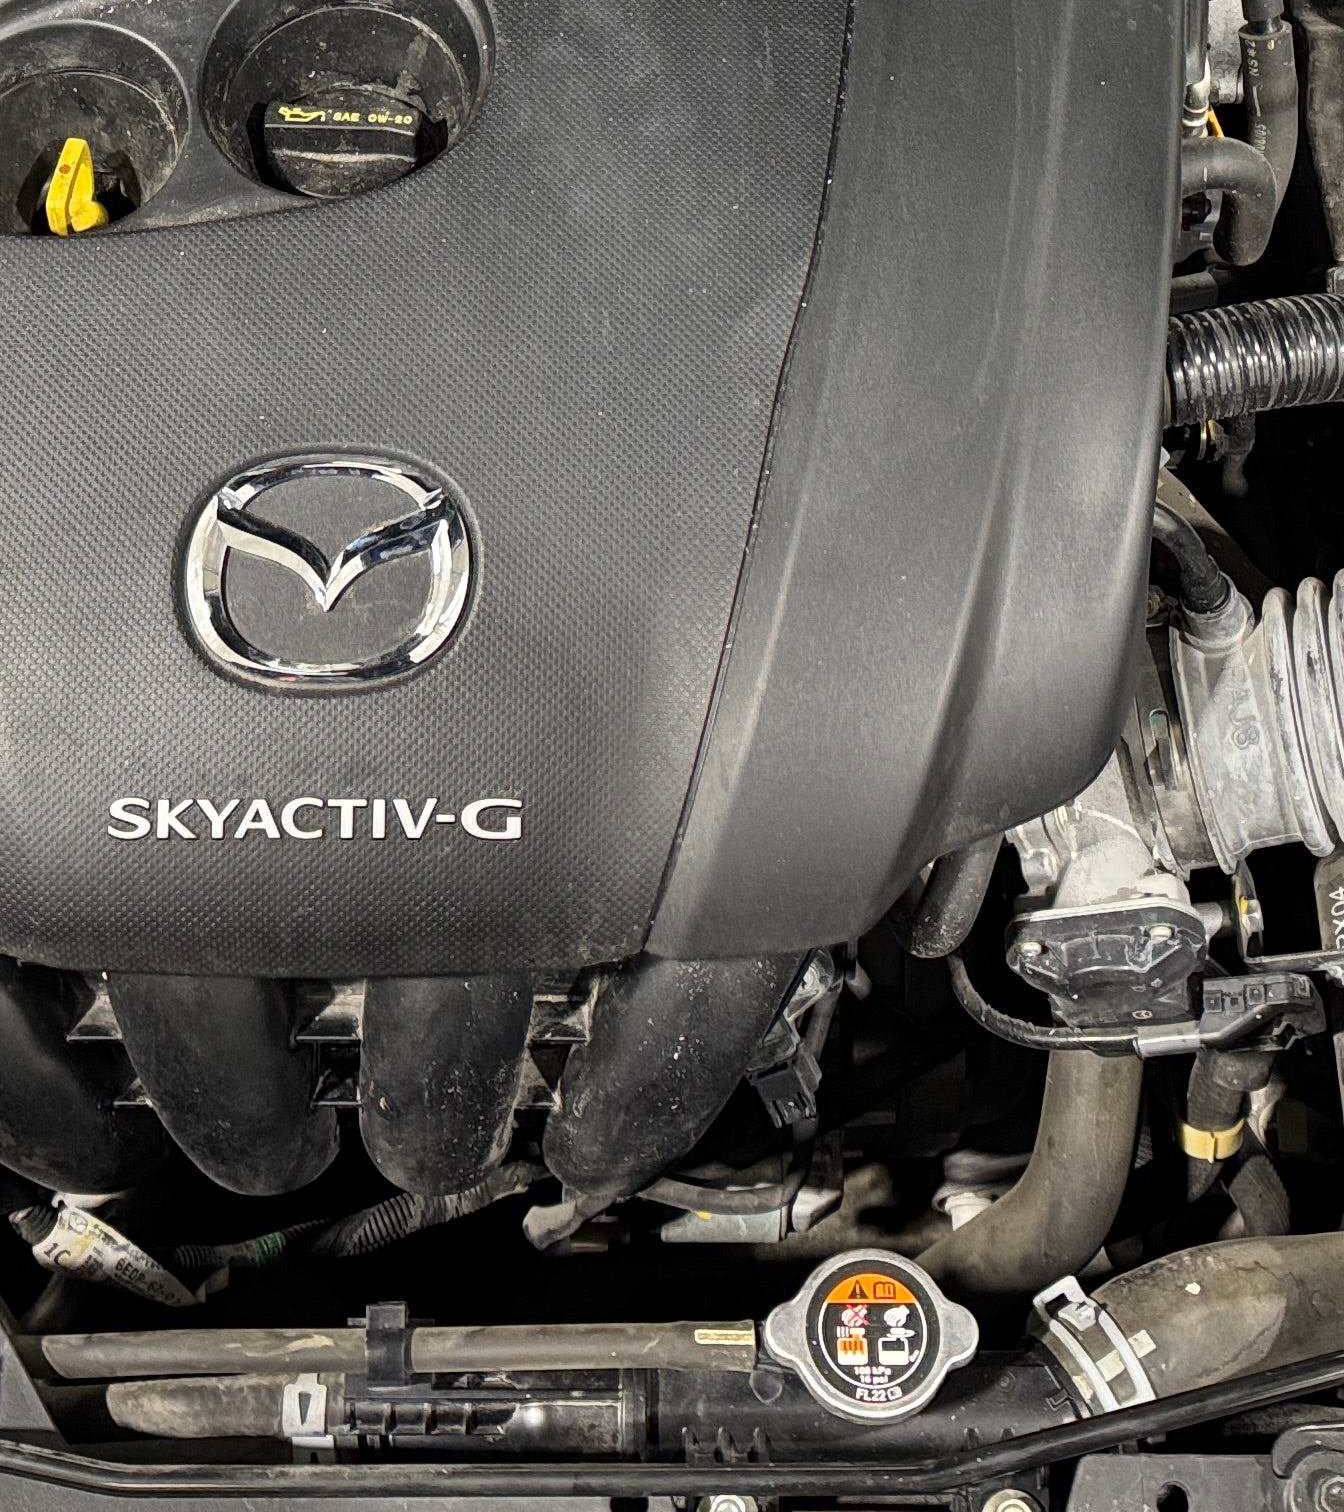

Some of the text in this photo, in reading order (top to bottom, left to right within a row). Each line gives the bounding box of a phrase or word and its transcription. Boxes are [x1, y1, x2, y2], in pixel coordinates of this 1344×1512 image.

[332, 111, 414, 125] SAE 0W-20
[107, 797, 523, 841] SKYACTIV-G
[872, 1366, 892, 1376] kPa
[873, 1376, 888, 1385] psi
[856, 1387, 887, 1402] FL22
